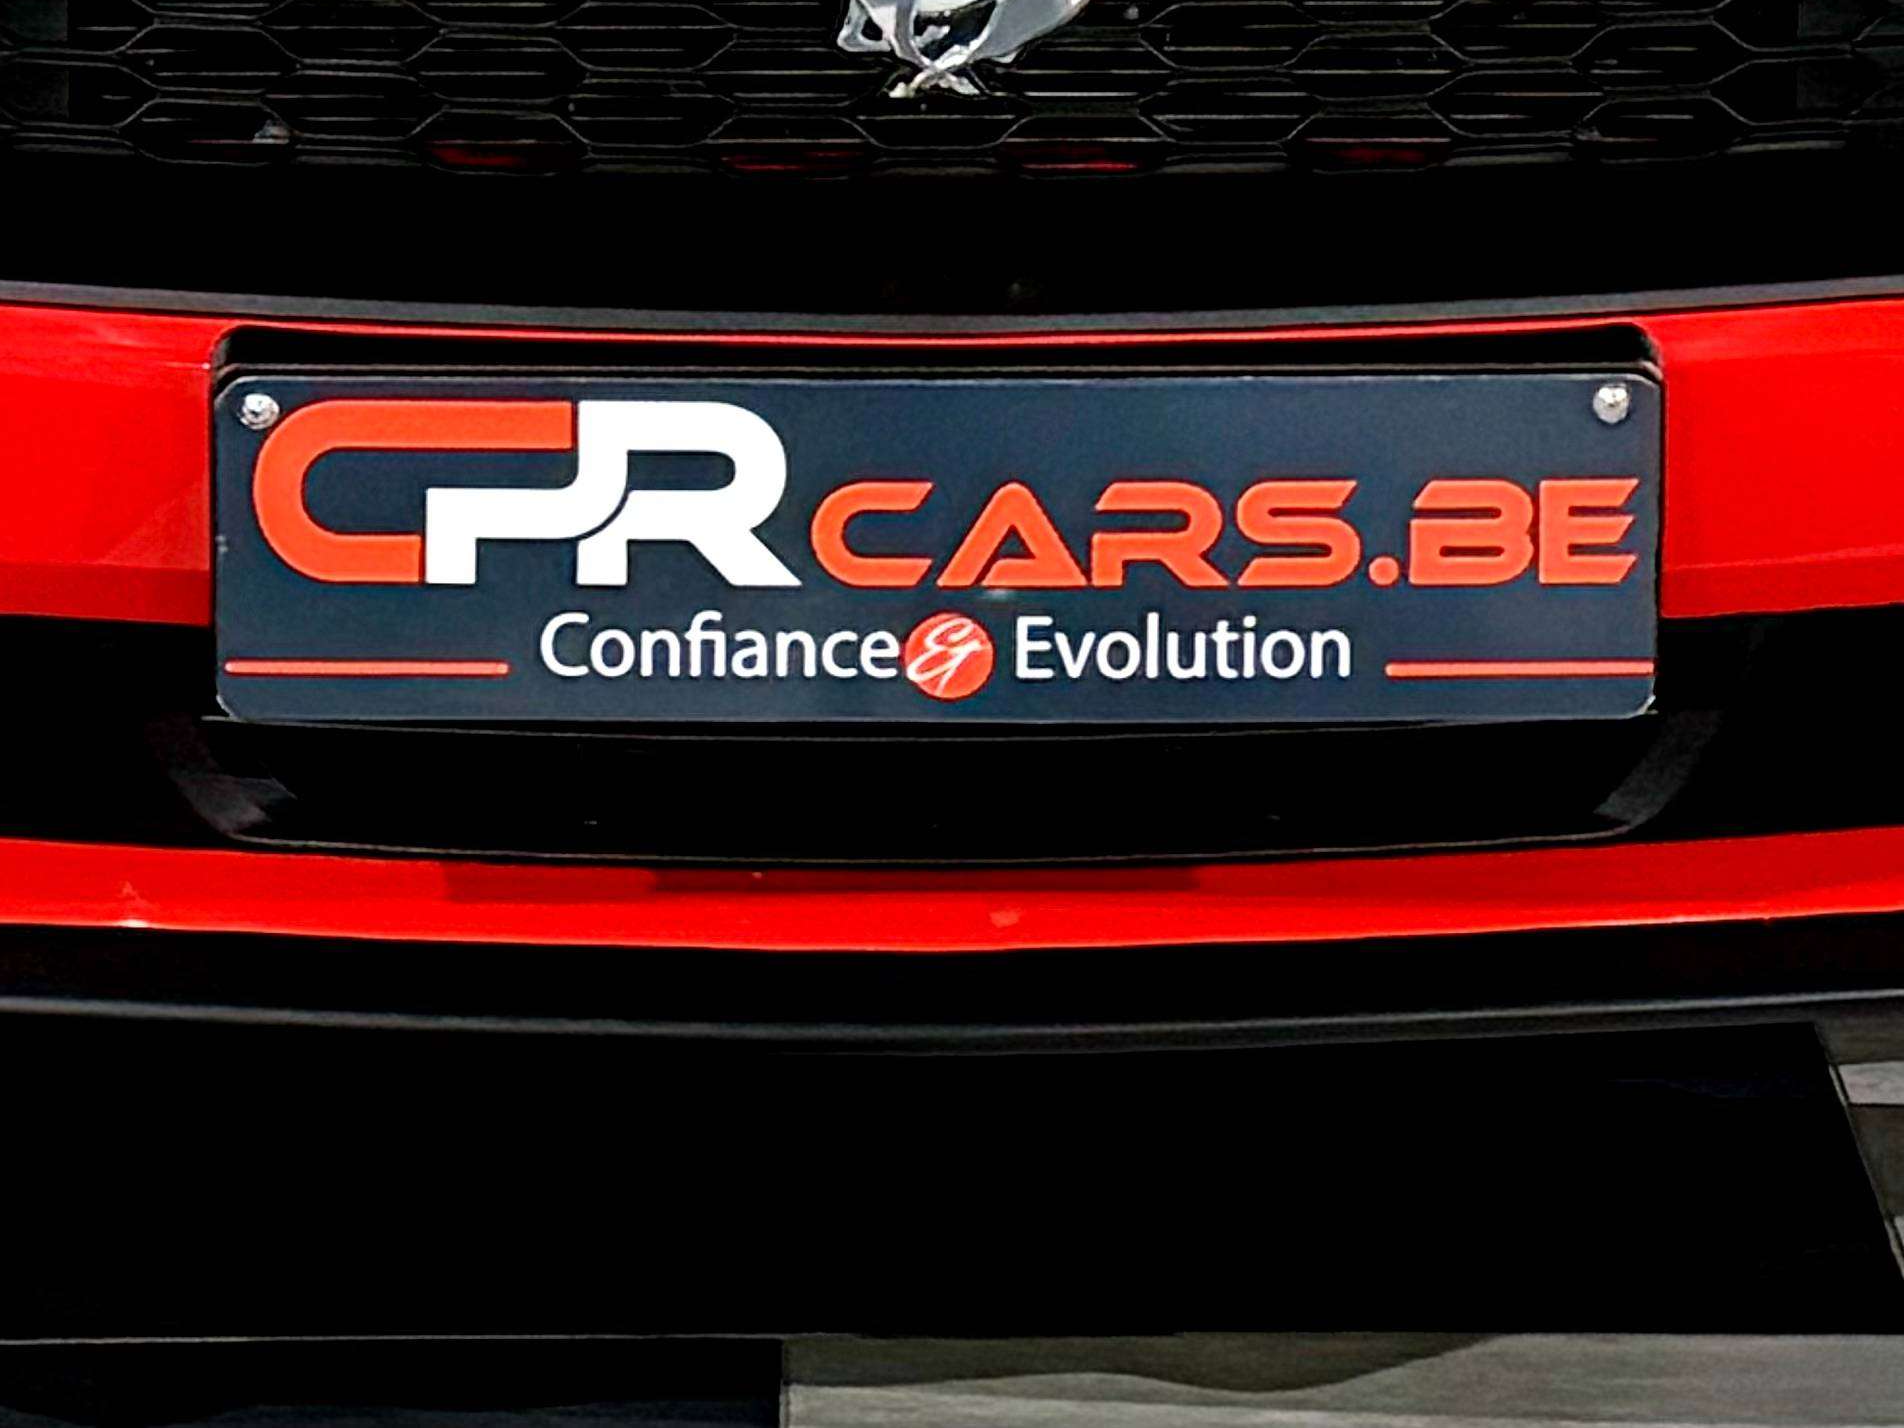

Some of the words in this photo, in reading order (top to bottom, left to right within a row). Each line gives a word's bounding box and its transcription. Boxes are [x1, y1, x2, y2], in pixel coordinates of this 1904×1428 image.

[251, 398, 803, 586] CPR
[809, 476, 1640, 589] CARS.BE
[539, 609, 899, 680] Confiance
[1015, 610, 1352, 681] Evolution
